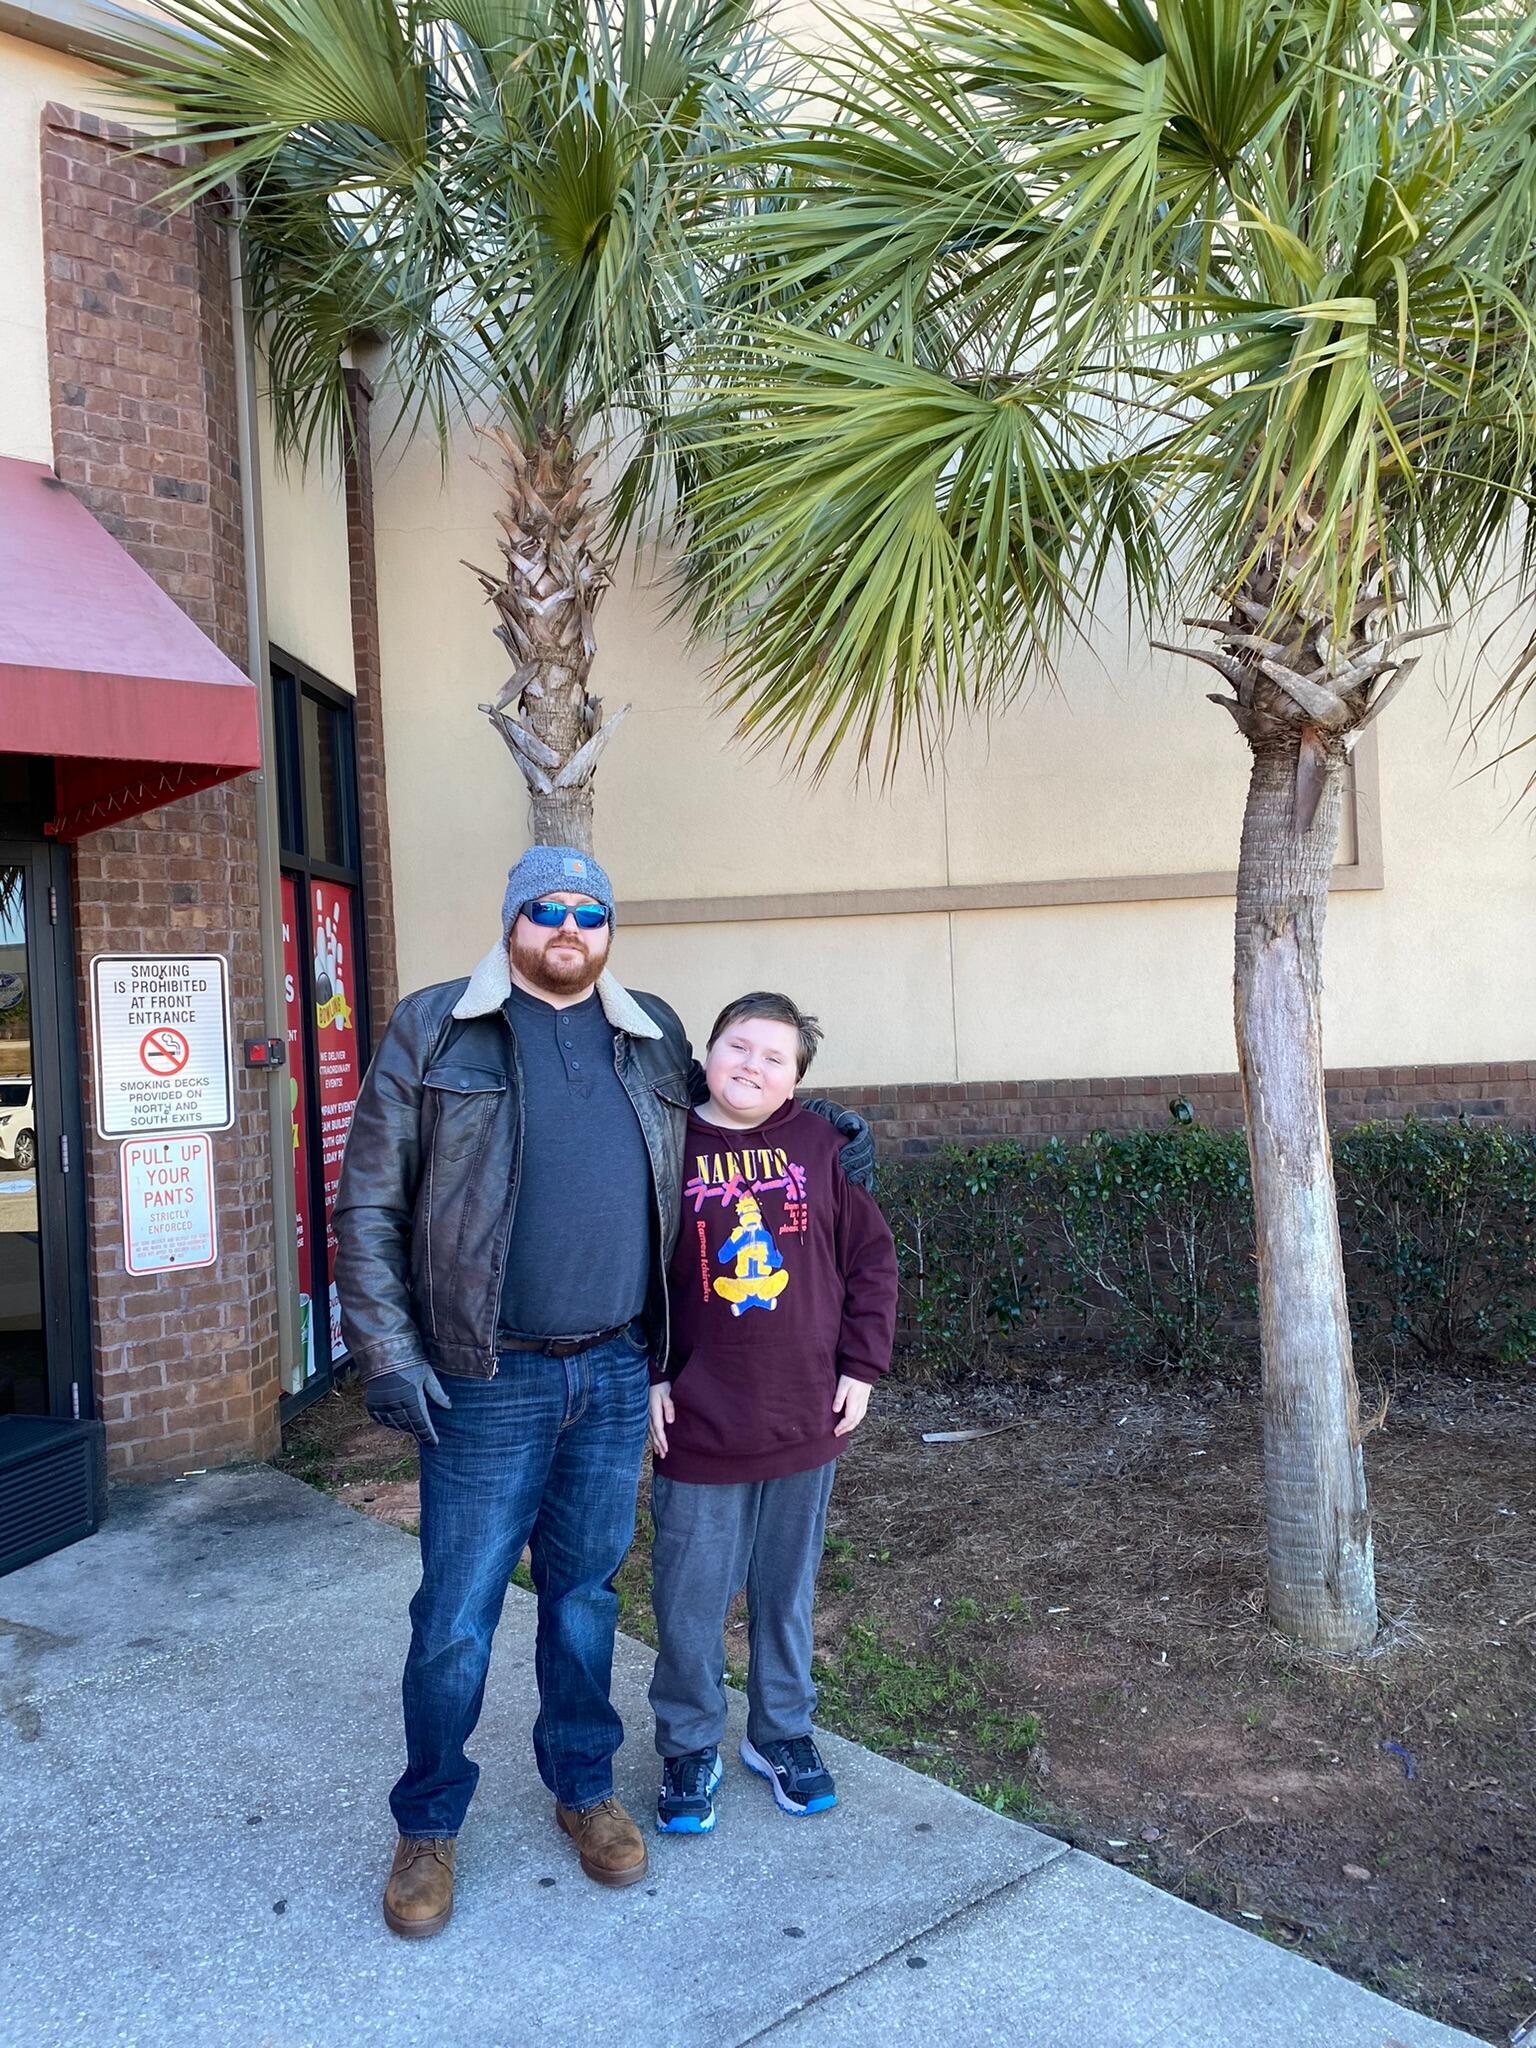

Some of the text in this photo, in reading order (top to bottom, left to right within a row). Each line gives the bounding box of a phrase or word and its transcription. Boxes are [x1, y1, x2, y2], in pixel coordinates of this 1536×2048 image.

[131, 964, 190, 978] SMOKING
[114, 980, 207, 994] IS PROHIBITED
[131, 995, 193, 1009] AT FRONT
[128, 1011, 196, 1025] ENTRANCE
[120, 1077, 210, 1091] SMOKING DECKS
[129, 1089, 202, 1103] PROVIDED ON
[134, 1101, 198, 1114] NORTH AND
[131, 1112, 202, 1127] SOUTH EXITS
[131, 1144, 202, 1167] PULL UP
[696, 1147, 788, 1186] NARUTO
[146, 1167, 190, 1186] YOUR
[144, 1187, 194, 1209] PANTS
[150, 1210, 190, 1223] STRICTLY
[148, 1221, 193, 1235] ENFORCED
